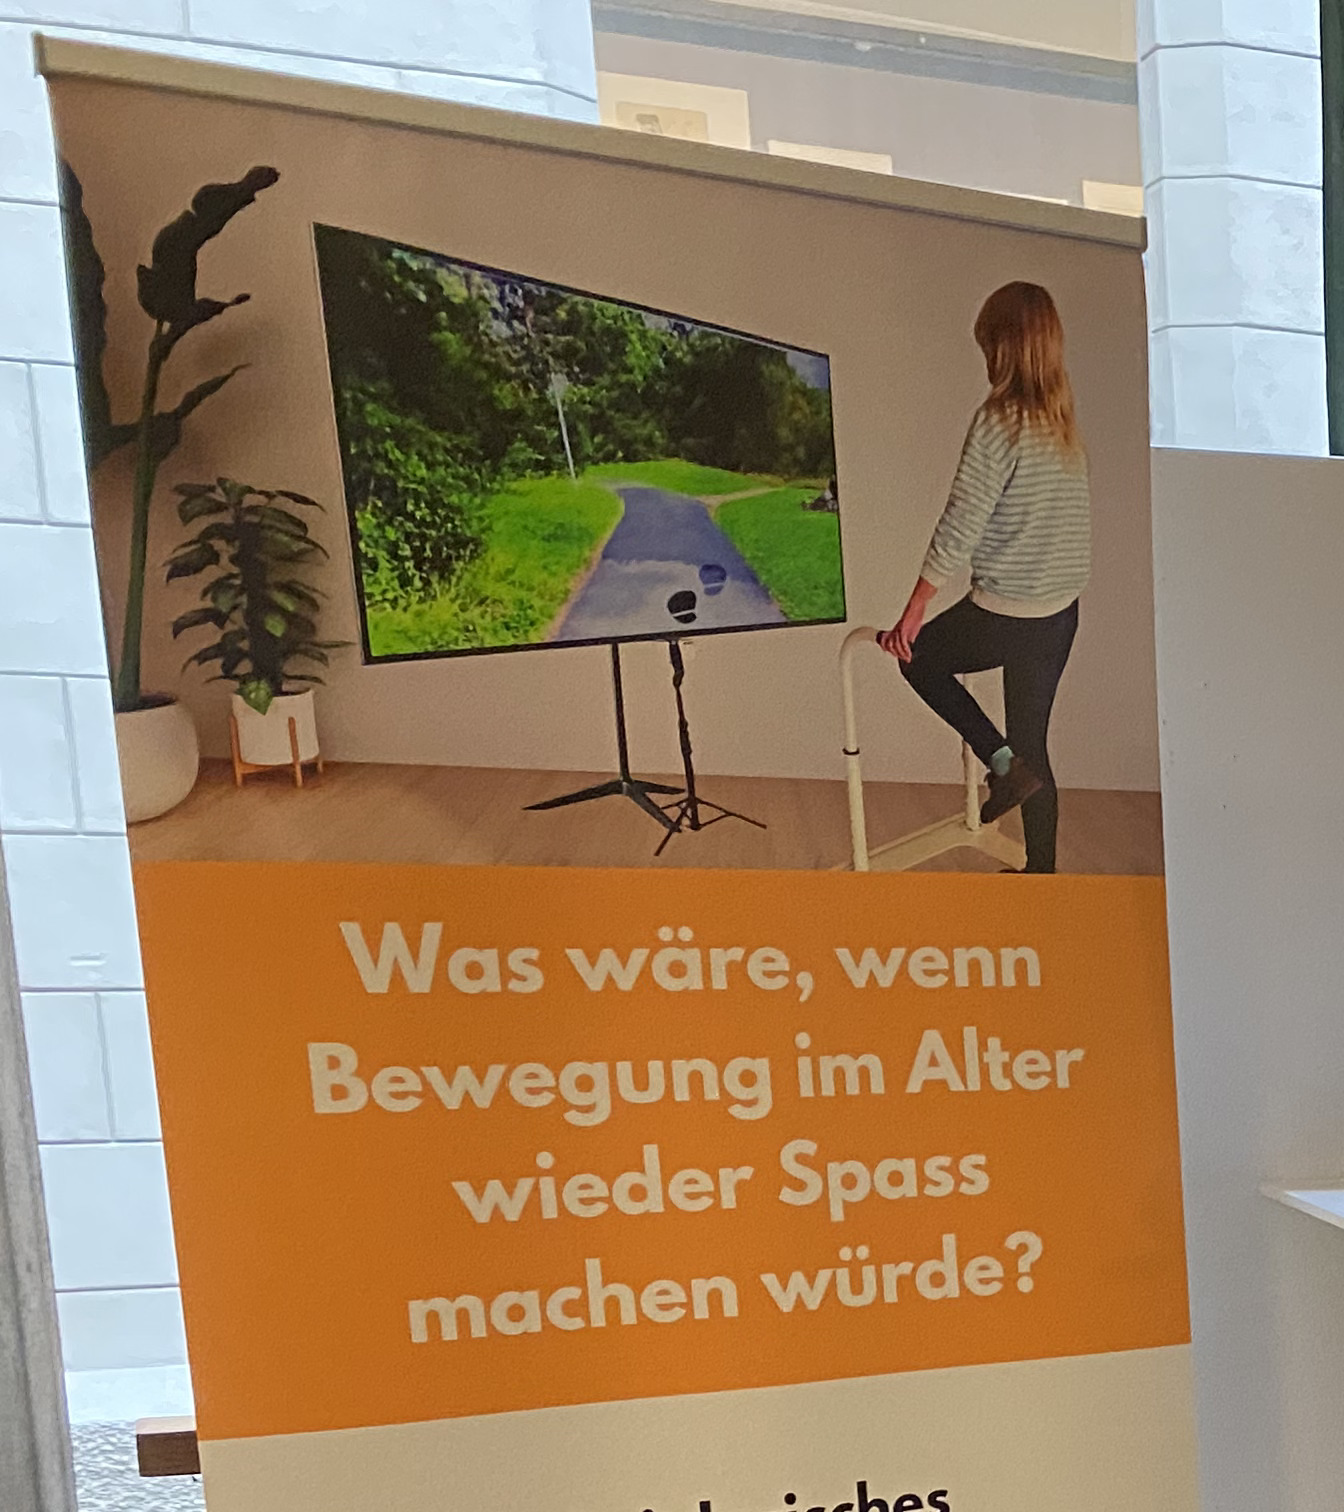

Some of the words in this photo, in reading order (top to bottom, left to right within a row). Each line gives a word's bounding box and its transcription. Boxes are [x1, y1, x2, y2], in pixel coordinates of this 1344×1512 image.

[339, 920, 545, 995] Was
[565, 926, 814, 1002] wäre,
[836, 940, 1043, 990] wenn
[307, 1041, 772, 1126] Bewegung
[795, 1034, 885, 1098] im
[906, 1025, 1086, 1096] Alter
[451, 1143, 754, 1225] wieder
[776, 1138, 990, 1222] Spass
[407, 1257, 739, 1343] machen
[760, 1229, 1045, 1313] würde?
